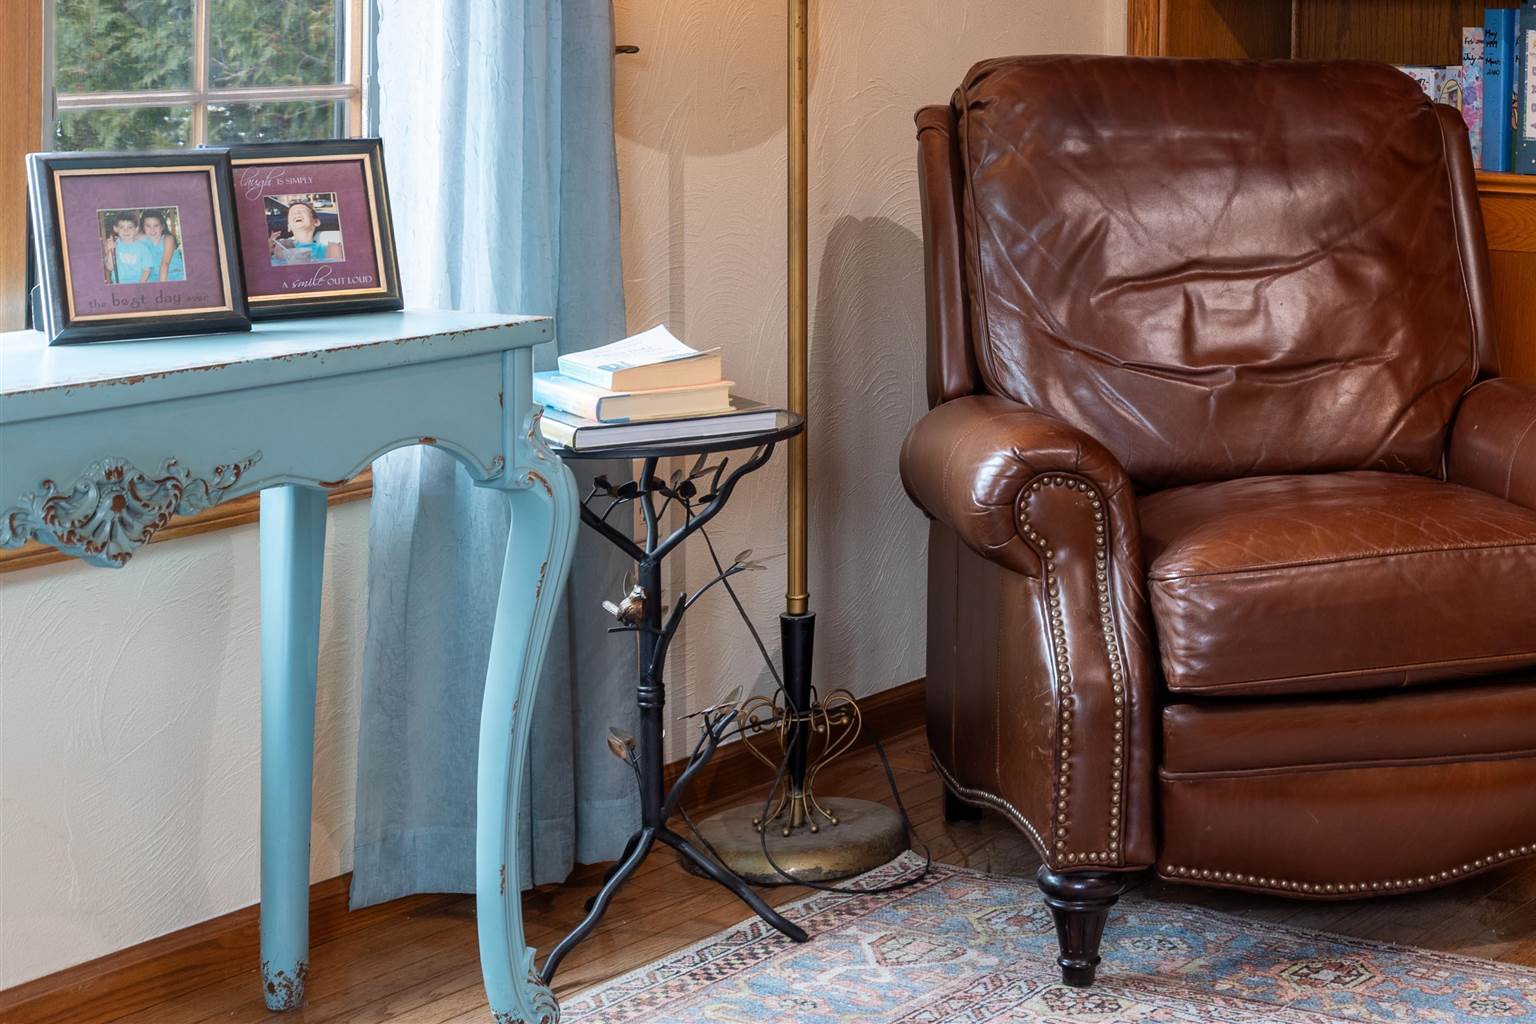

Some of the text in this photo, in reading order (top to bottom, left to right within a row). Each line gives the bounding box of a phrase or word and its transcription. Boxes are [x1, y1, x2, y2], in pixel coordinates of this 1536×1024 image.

[240, 168, 287, 200] laugh
[286, 176, 312, 184] SIMPLY
[292, 265, 332, 289] smile
[327, 277, 345, 286] OUT
[347, 275, 372, 285] LOUD
[88, 298, 106, 309] the
[111, 292, 146, 309] best
[155, 289, 181, 306] day
